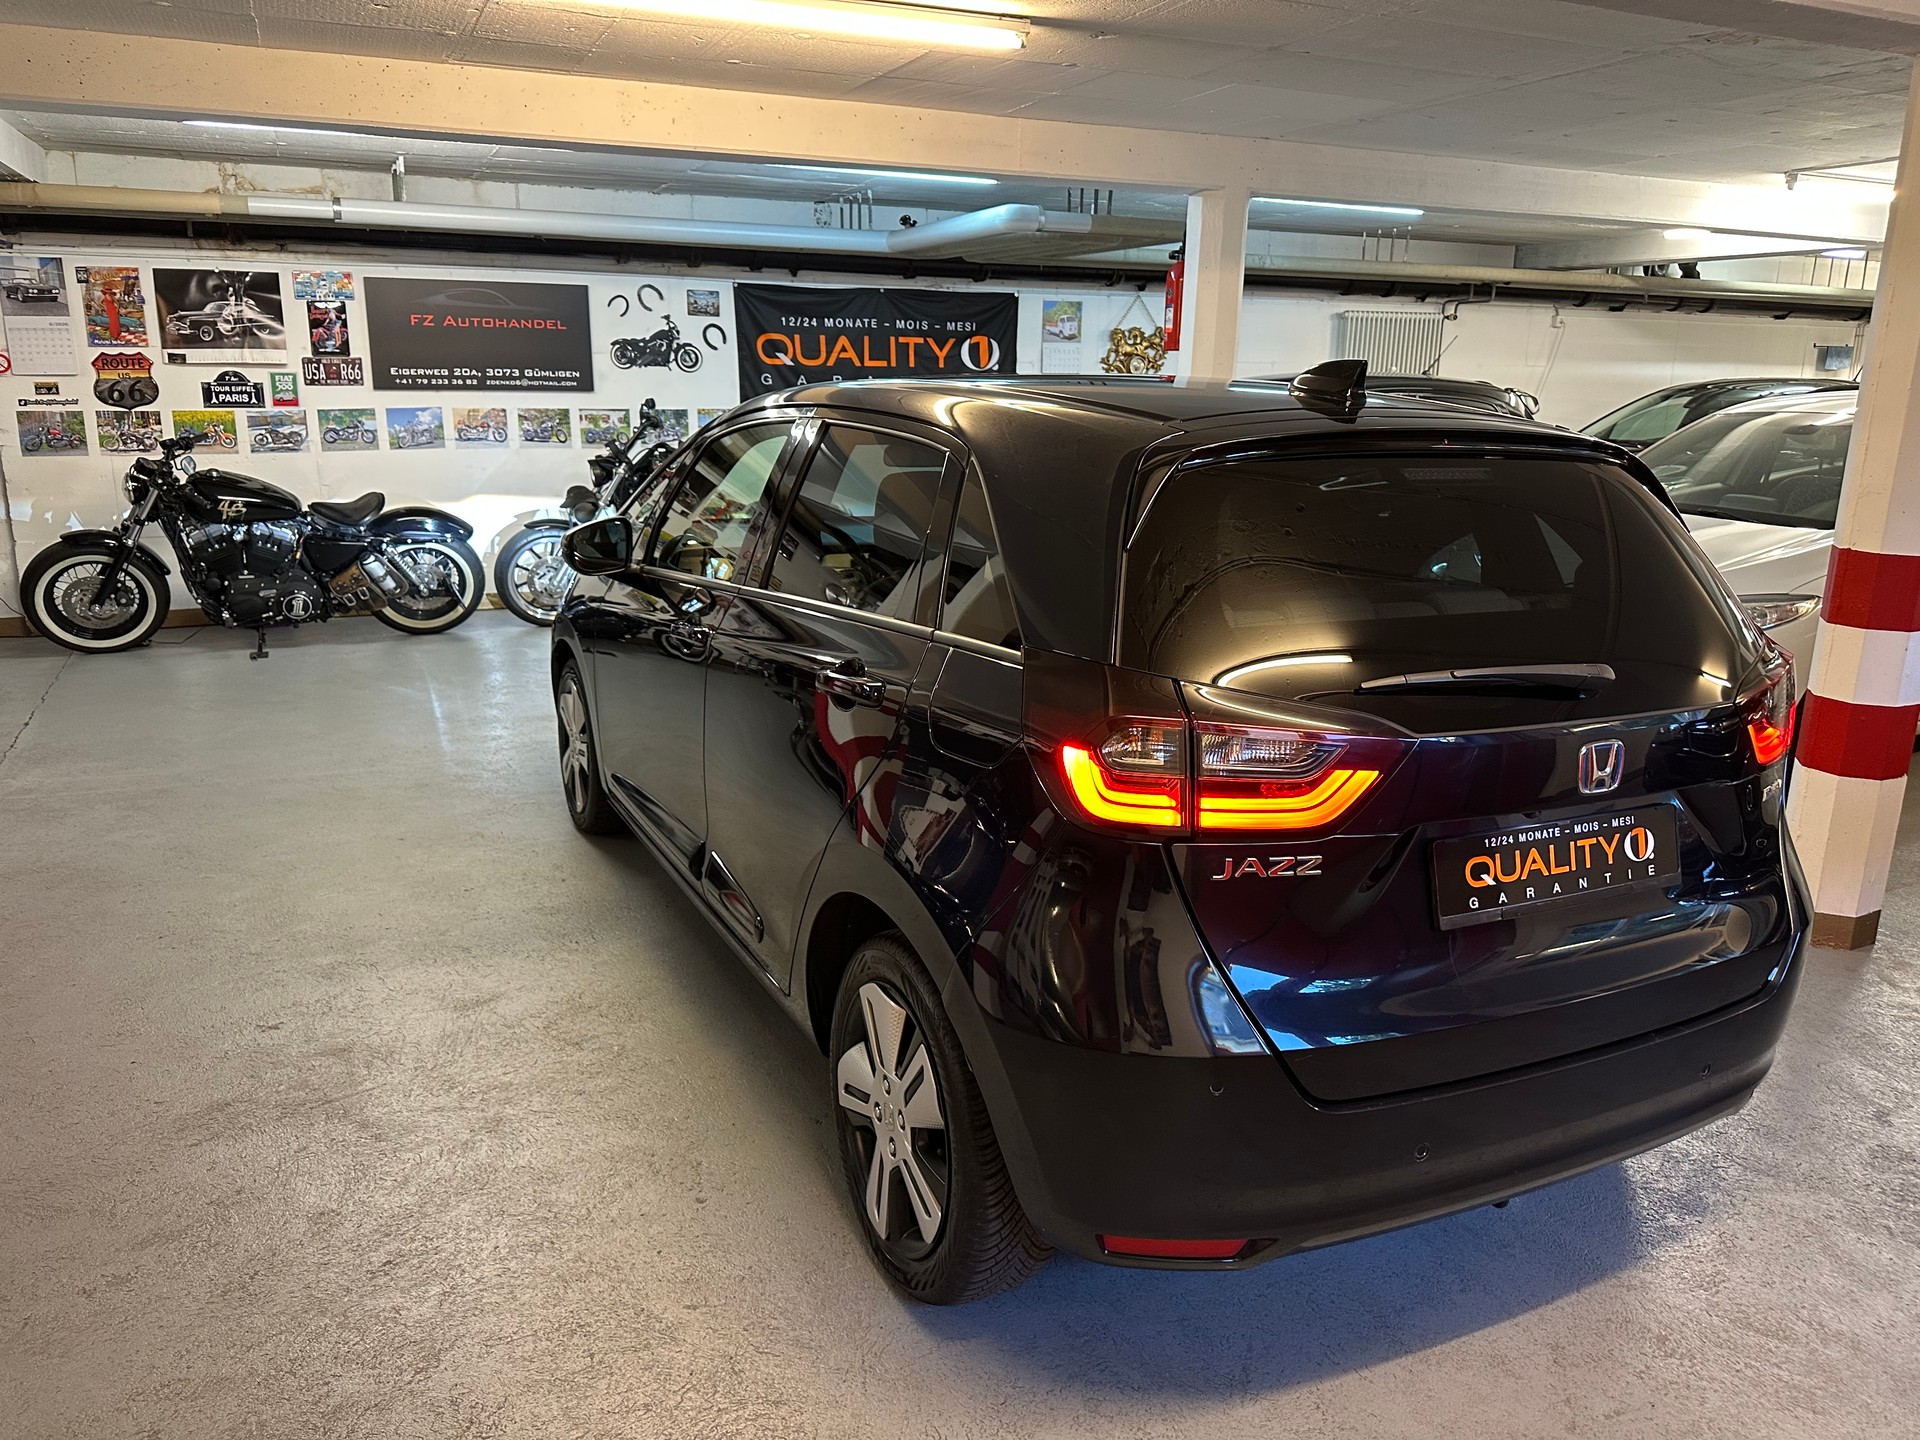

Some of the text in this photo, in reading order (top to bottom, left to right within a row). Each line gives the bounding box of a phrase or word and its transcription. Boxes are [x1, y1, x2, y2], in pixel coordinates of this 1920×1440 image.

[410, 314, 435, 327] FZ
[781, 316, 818, 328] 12/24
[824, 317, 878, 329] MONATE
[896, 319, 929, 331] MOIS
[946, 321, 977, 332] MESI
[756, 332, 957, 369] QUALITY
[101, 357, 145, 369] ROUTE
[304, 363, 361, 380] USA R66
[486, 368, 520, 377] 3073
[108, 380, 146, 402] 66
[276, 382, 293, 391] 500
[219, 394, 249, 402] PARIS
[1485, 835, 1514, 848] 12/24
[1519, 828, 1561, 842] MONATE
[1575, 822, 1599, 834] MOIS
[1612, 816, 1635, 828] MESI
[1211, 856, 1322, 880] JAZZ
[1465, 834, 1621, 888] QUALITY
[1469, 865, 1656, 909] GARANTIE
